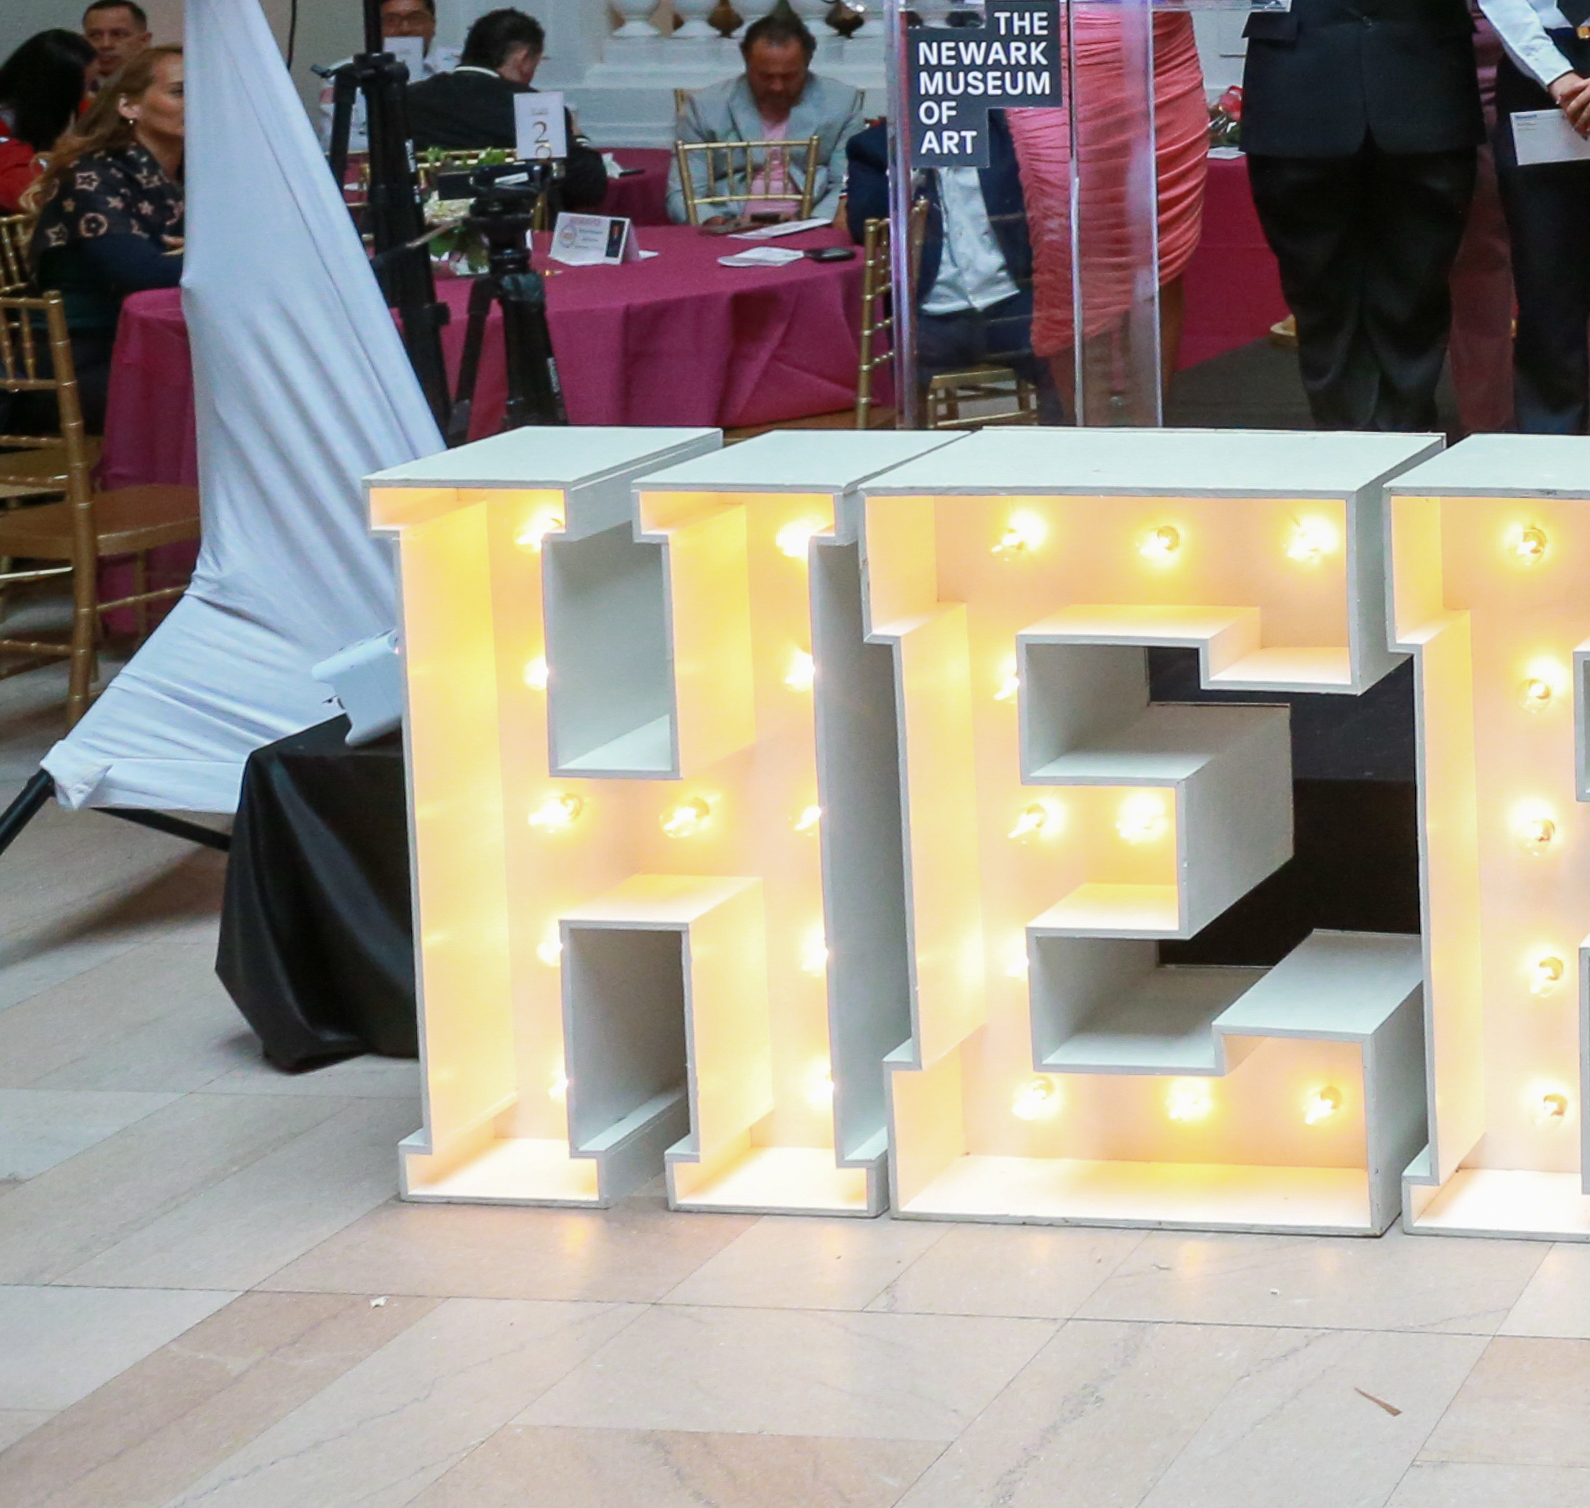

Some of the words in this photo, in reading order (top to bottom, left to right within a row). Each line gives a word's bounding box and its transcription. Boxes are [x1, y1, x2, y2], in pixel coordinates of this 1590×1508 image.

[994, 11, 1049, 36] THE
[918, 41, 1049, 66] NEWARK
[918, 71, 1051, 96] MUSEUM
[918, 100, 957, 125] OF
[532, 120, 549, 143] 2
[920, 129, 978, 155] ART
